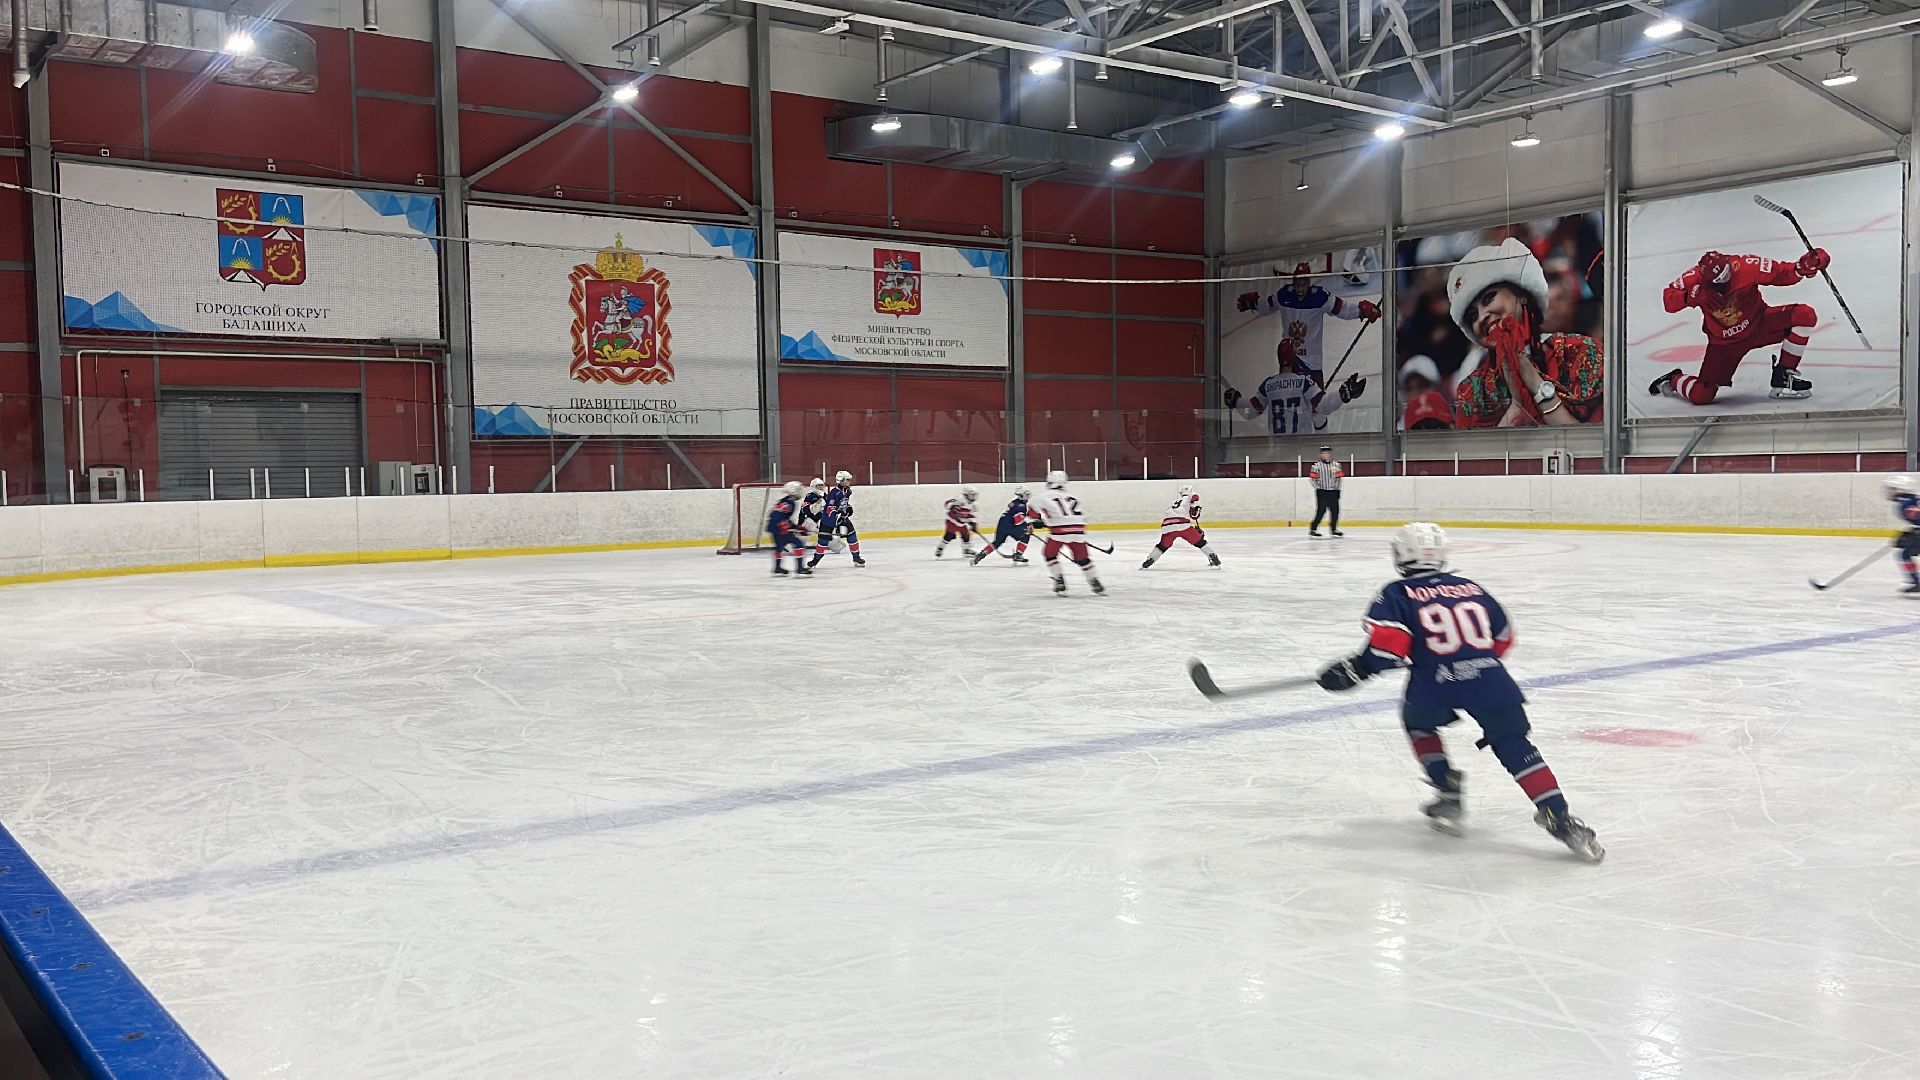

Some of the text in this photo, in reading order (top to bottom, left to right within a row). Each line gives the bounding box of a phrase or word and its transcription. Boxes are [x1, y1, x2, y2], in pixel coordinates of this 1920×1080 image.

[195, 302, 331, 319] ГОРОДСКОЙ ОКРУГ
[222, 318, 307, 332] БАЛАШИХА
[867, 325, 931, 336] МИНИСТЕРСТВО
[1722, 319, 1750, 338] РОССИЯ
[831, 334, 965, 348] ФИЗИЧЕСКОЙ КУЛЬТУРЫ И СПОРТА
[854, 347, 946, 358] МОСКОВСКОЙ ОБЛАСТИ
[570, 398, 677, 410] ПРАВИТЕЛЬСТВО
[547, 411, 699, 424] МОСКОВСКОЙ ОБЛАСТИ
[1271, 396, 1301, 434] 87
[1052, 497, 1083, 517] 12
[1418, 600, 1495, 655] 90
